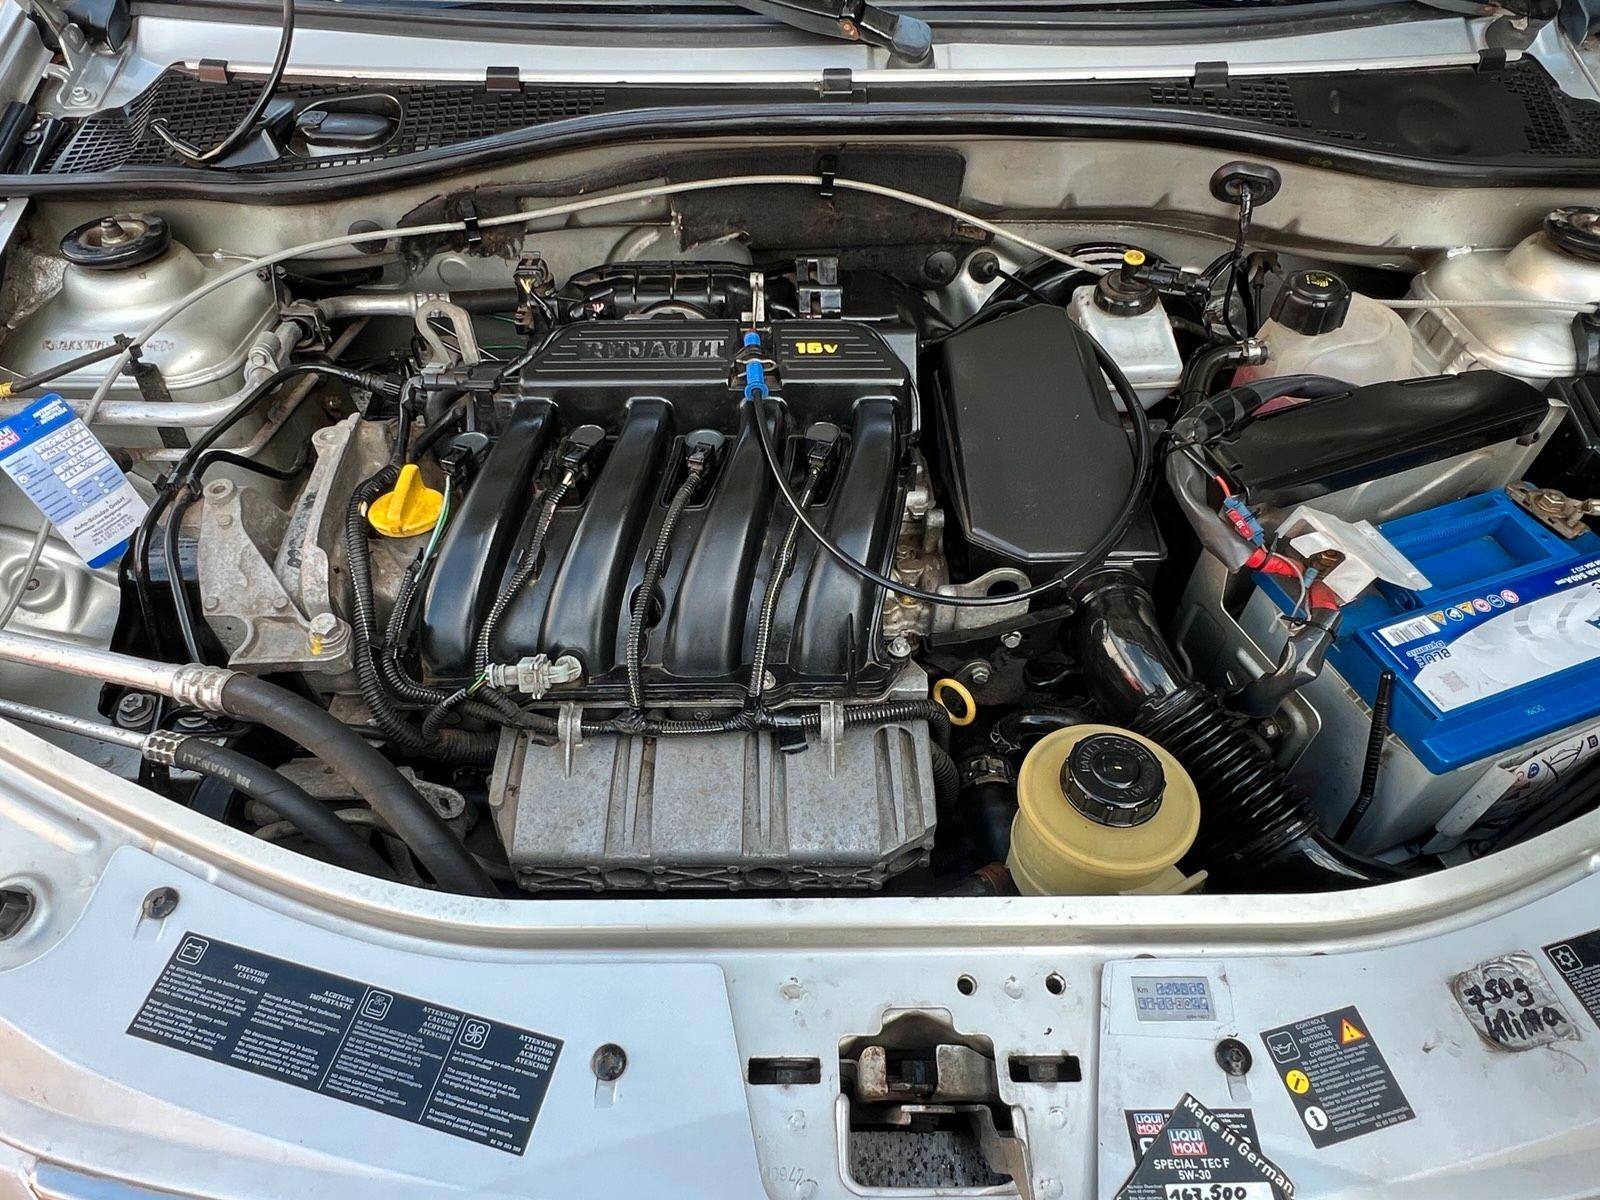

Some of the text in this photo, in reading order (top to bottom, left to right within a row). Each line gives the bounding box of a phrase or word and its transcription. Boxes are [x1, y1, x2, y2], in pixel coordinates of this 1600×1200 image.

[583, 340, 725, 359] RENAULT
[1406, 639, 1445, 658] Dynamic
[1415, 648, 1451, 668] BLUE
[233, 964, 269, 978] ATTENTION
[237, 972, 265, 984] CAUTION
[310, 994, 351, 1009] IMPORTANTE
[324, 991, 354, 1003] ACHTUNG
[423, 1007, 459, 1021] ATTENTION
[428, 1015, 457, 1027] CAUTION
[423, 1022, 454, 1034] ACHTUNG
[1302, 1024, 1329, 1035] CONTROL
[519, 1035, 556, 1049] ATTENTION
[1299, 1030, 1332, 1043] KONTROLLE
[1309, 1037, 1336, 1049] CONTROL
[524, 1044, 553, 1056] CAUTION
[520, 1050, 551, 1063] ACHTUNG
[1135, 1115, 1162, 1124] LIQUI
[1184, 1097, 1220, 1131] Made
[1221, 1127, 1237, 1146] in
[1138, 1124, 1163, 1134] MOLY
[1170, 1130, 1202, 1141] LIQUI
[1174, 1142, 1206, 1154] MOLY
[1154, 1158, 1230, 1170] SPECIAL TEC F
[1178, 1170, 1212, 1181] 5W-30
